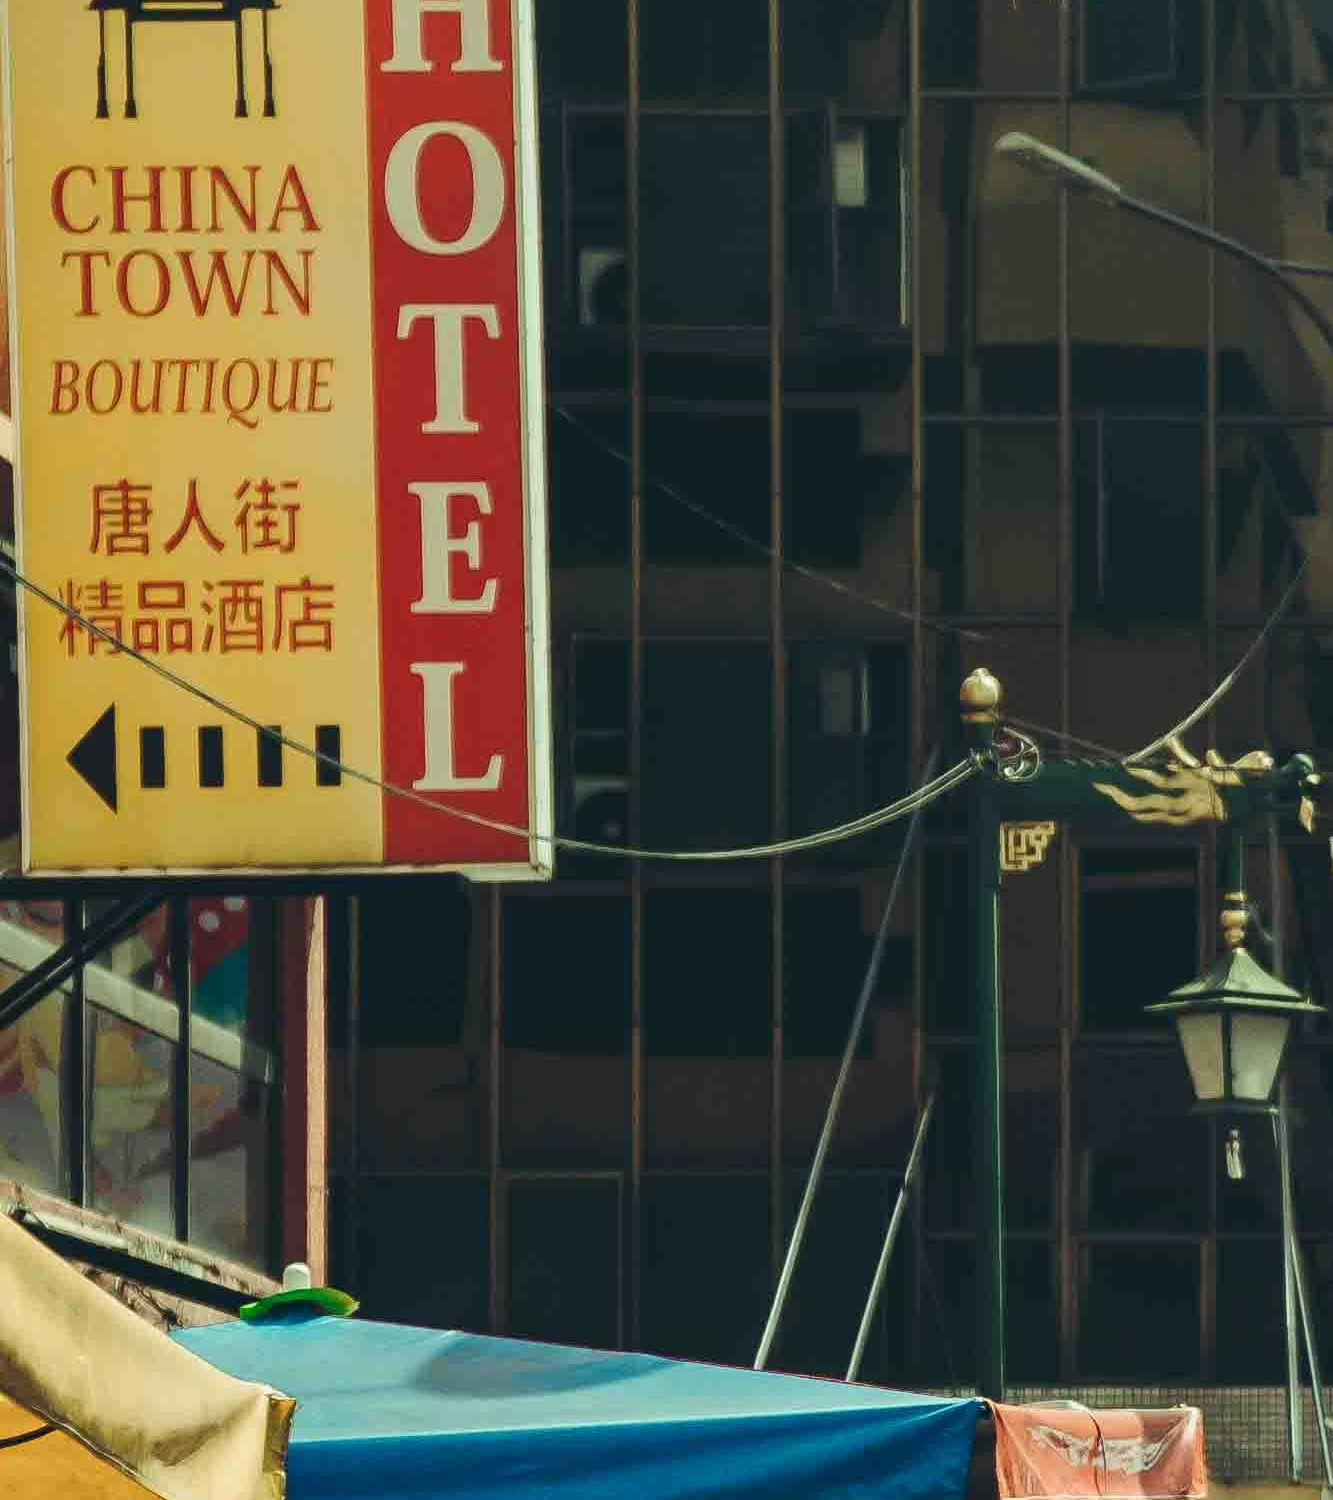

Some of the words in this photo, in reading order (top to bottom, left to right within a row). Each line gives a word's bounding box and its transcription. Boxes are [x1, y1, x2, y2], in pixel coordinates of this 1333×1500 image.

[50, 163, 322, 236] CHINA
[61, 246, 316, 319] TOWN
[49, 356, 335, 428] BOUTIQUE
[88, 477, 301, 557] 唐人街
[57, 577, 335, 657] 精品酒店
